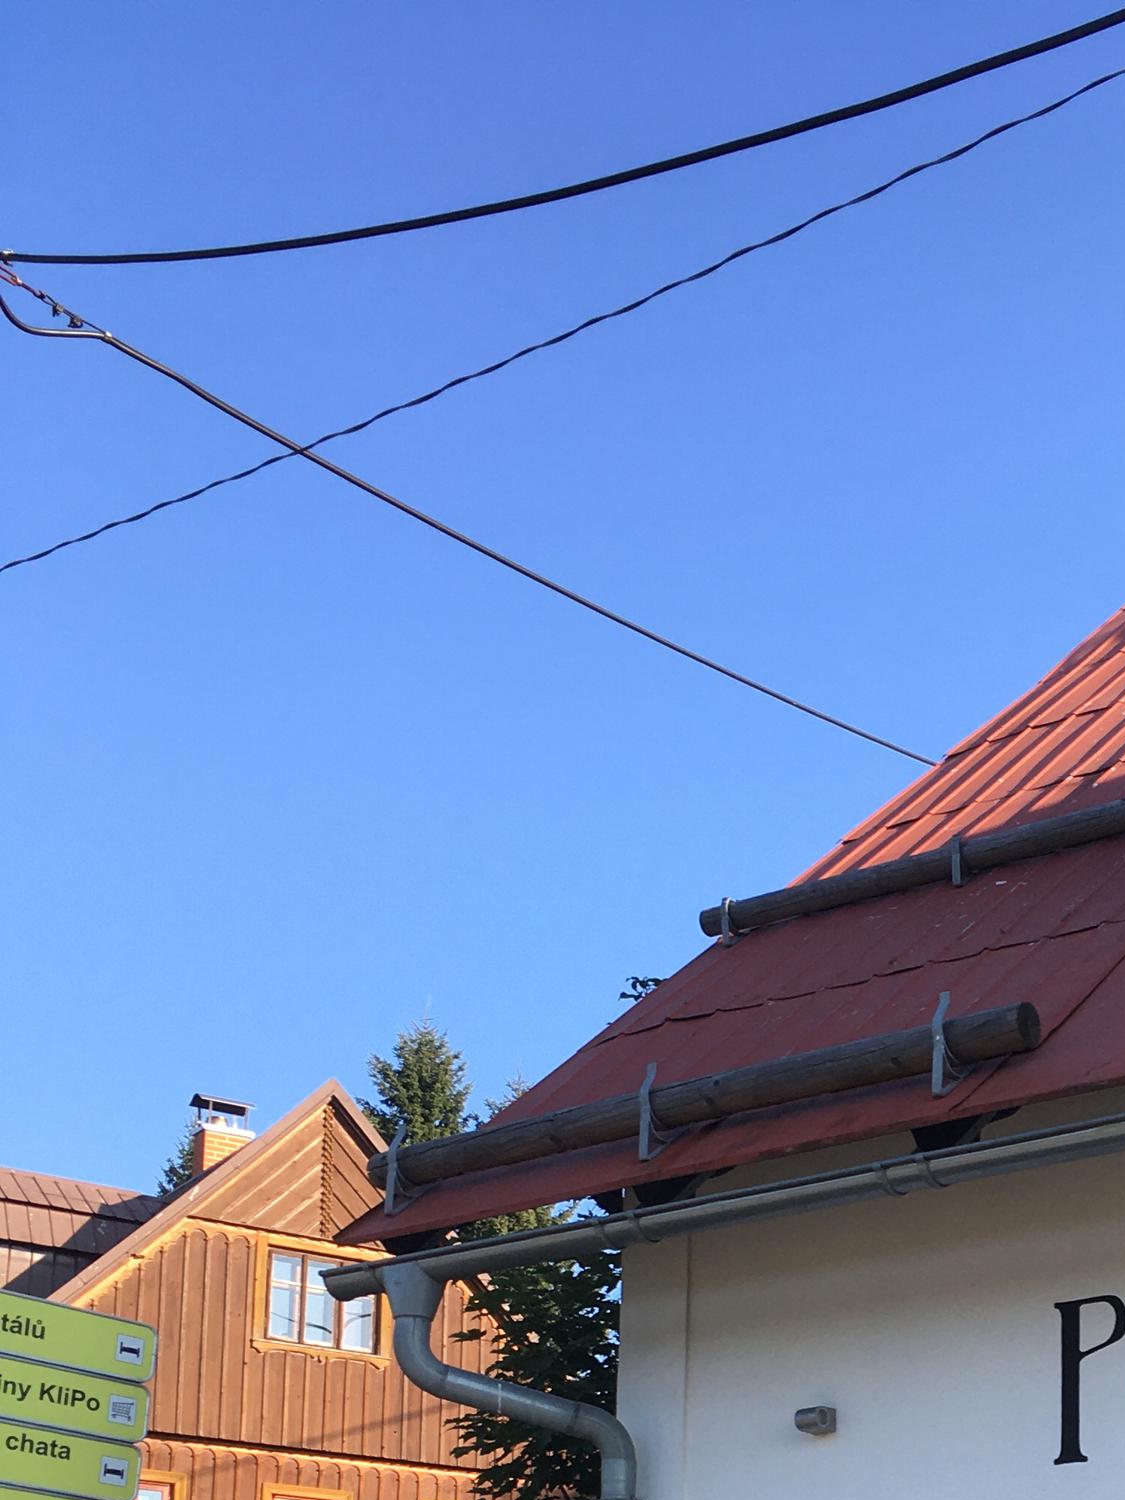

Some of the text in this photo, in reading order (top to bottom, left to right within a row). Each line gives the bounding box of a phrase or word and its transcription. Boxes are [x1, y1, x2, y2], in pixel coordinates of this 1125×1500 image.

[1, 1313, 46, 1340] tálů
[39, 1382, 100, 1412] KliPo
[5, 1433, 71, 1461] chata
